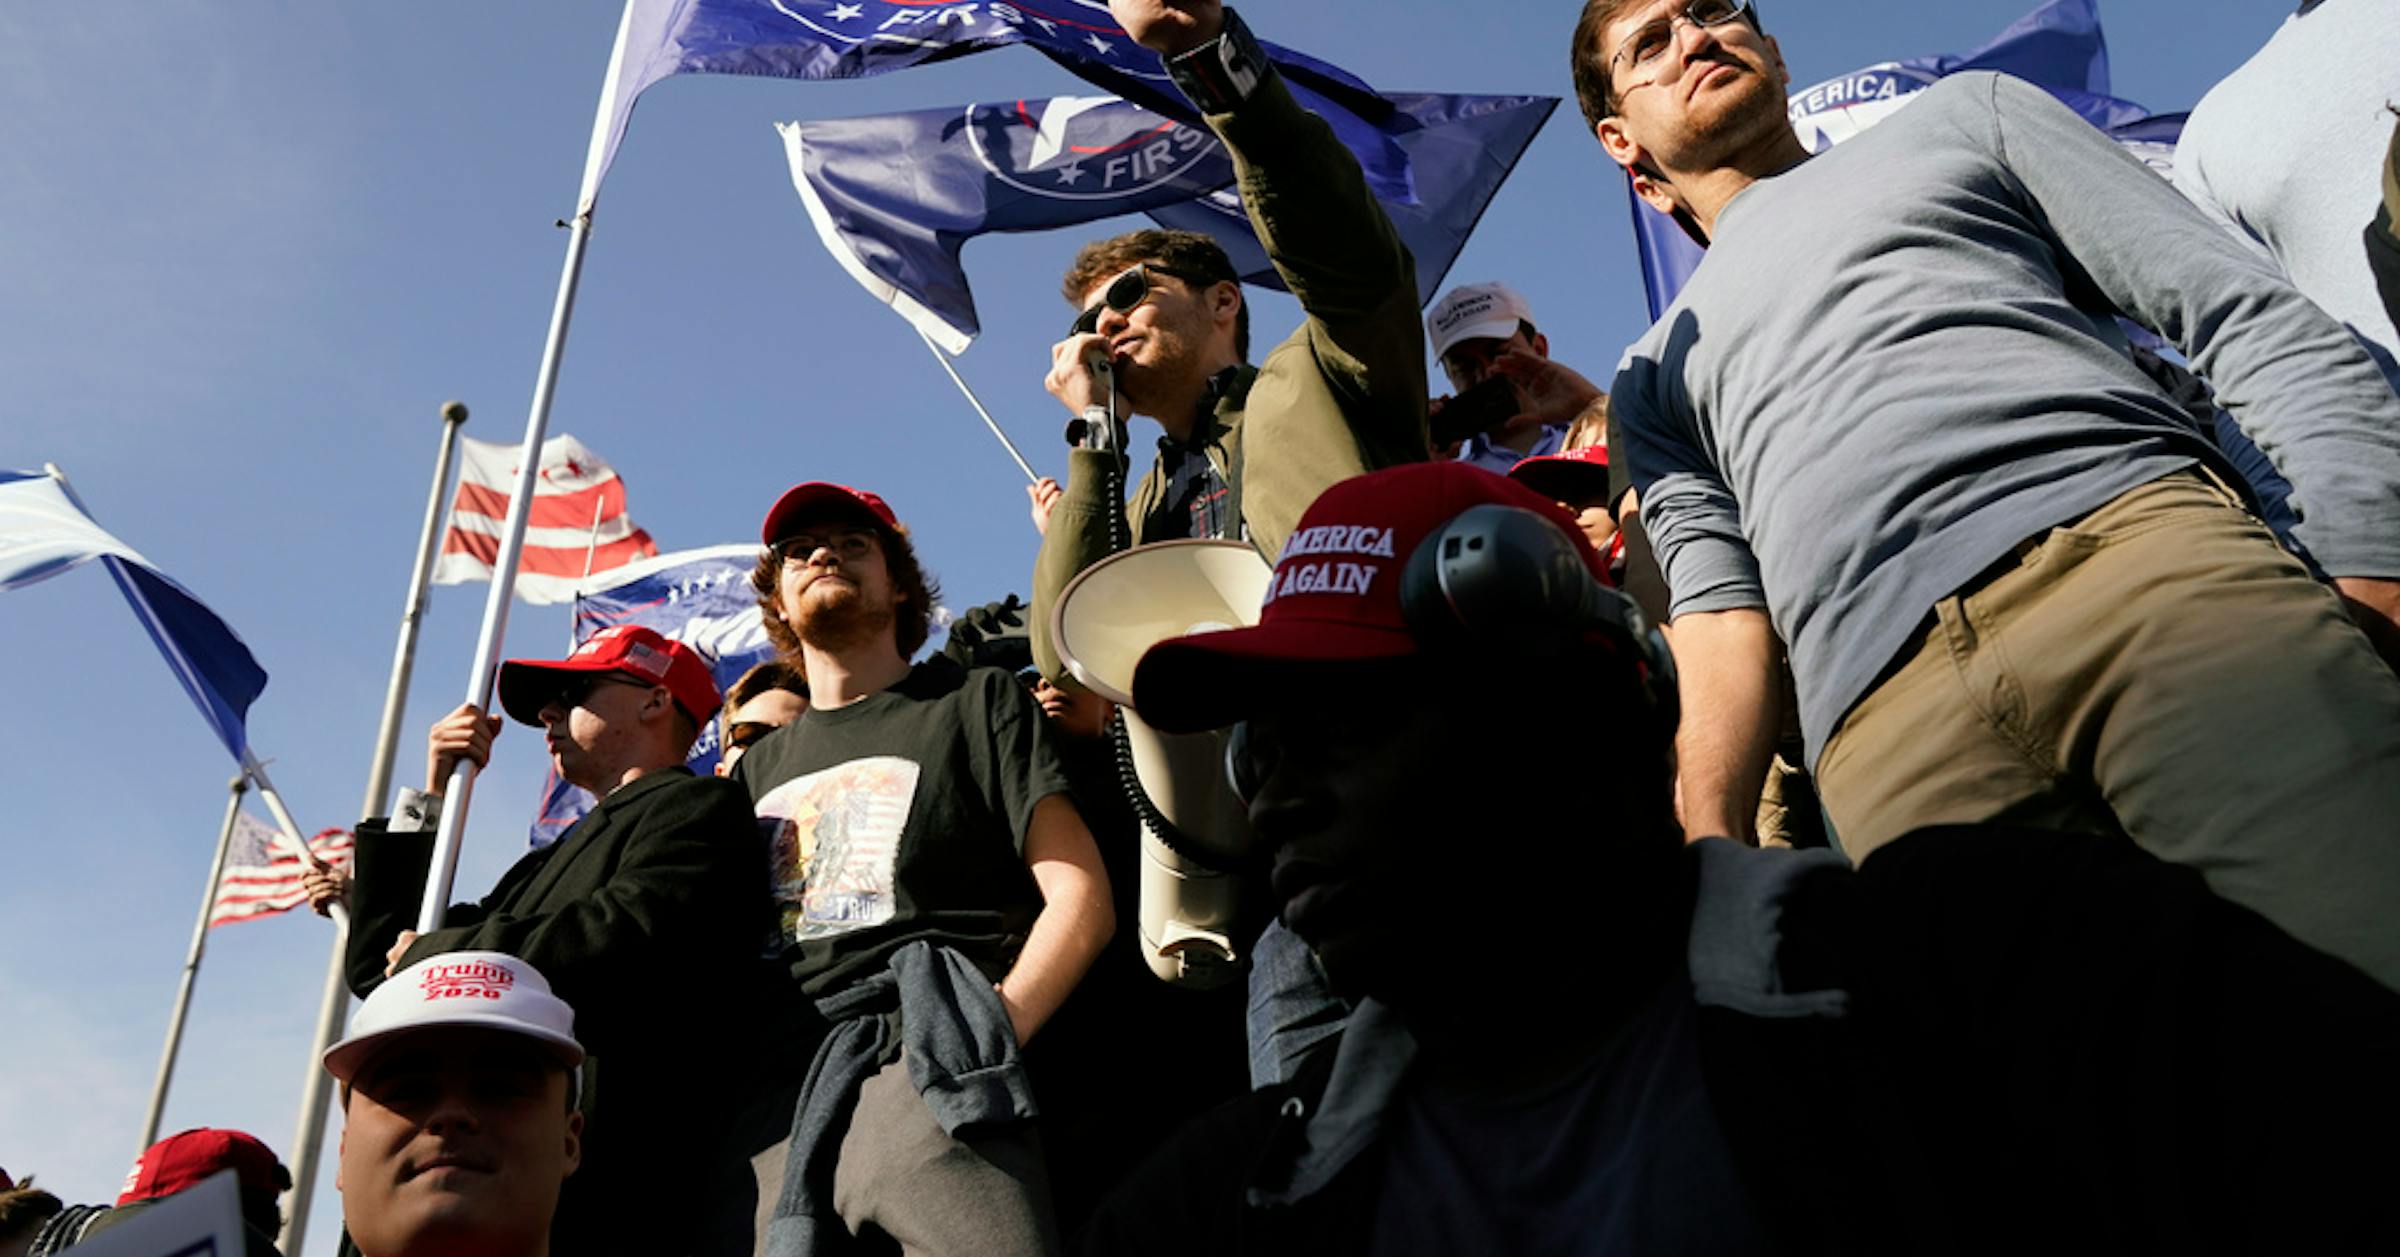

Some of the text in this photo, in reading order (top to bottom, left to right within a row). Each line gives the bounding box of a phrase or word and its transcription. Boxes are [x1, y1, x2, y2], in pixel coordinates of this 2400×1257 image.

[1789, 74, 1897, 121] MERICA
[1103, 123, 1204, 189] FIRS
[1278, 561, 1379, 597] AGAIN
[835, 896, 874, 920] TRU
